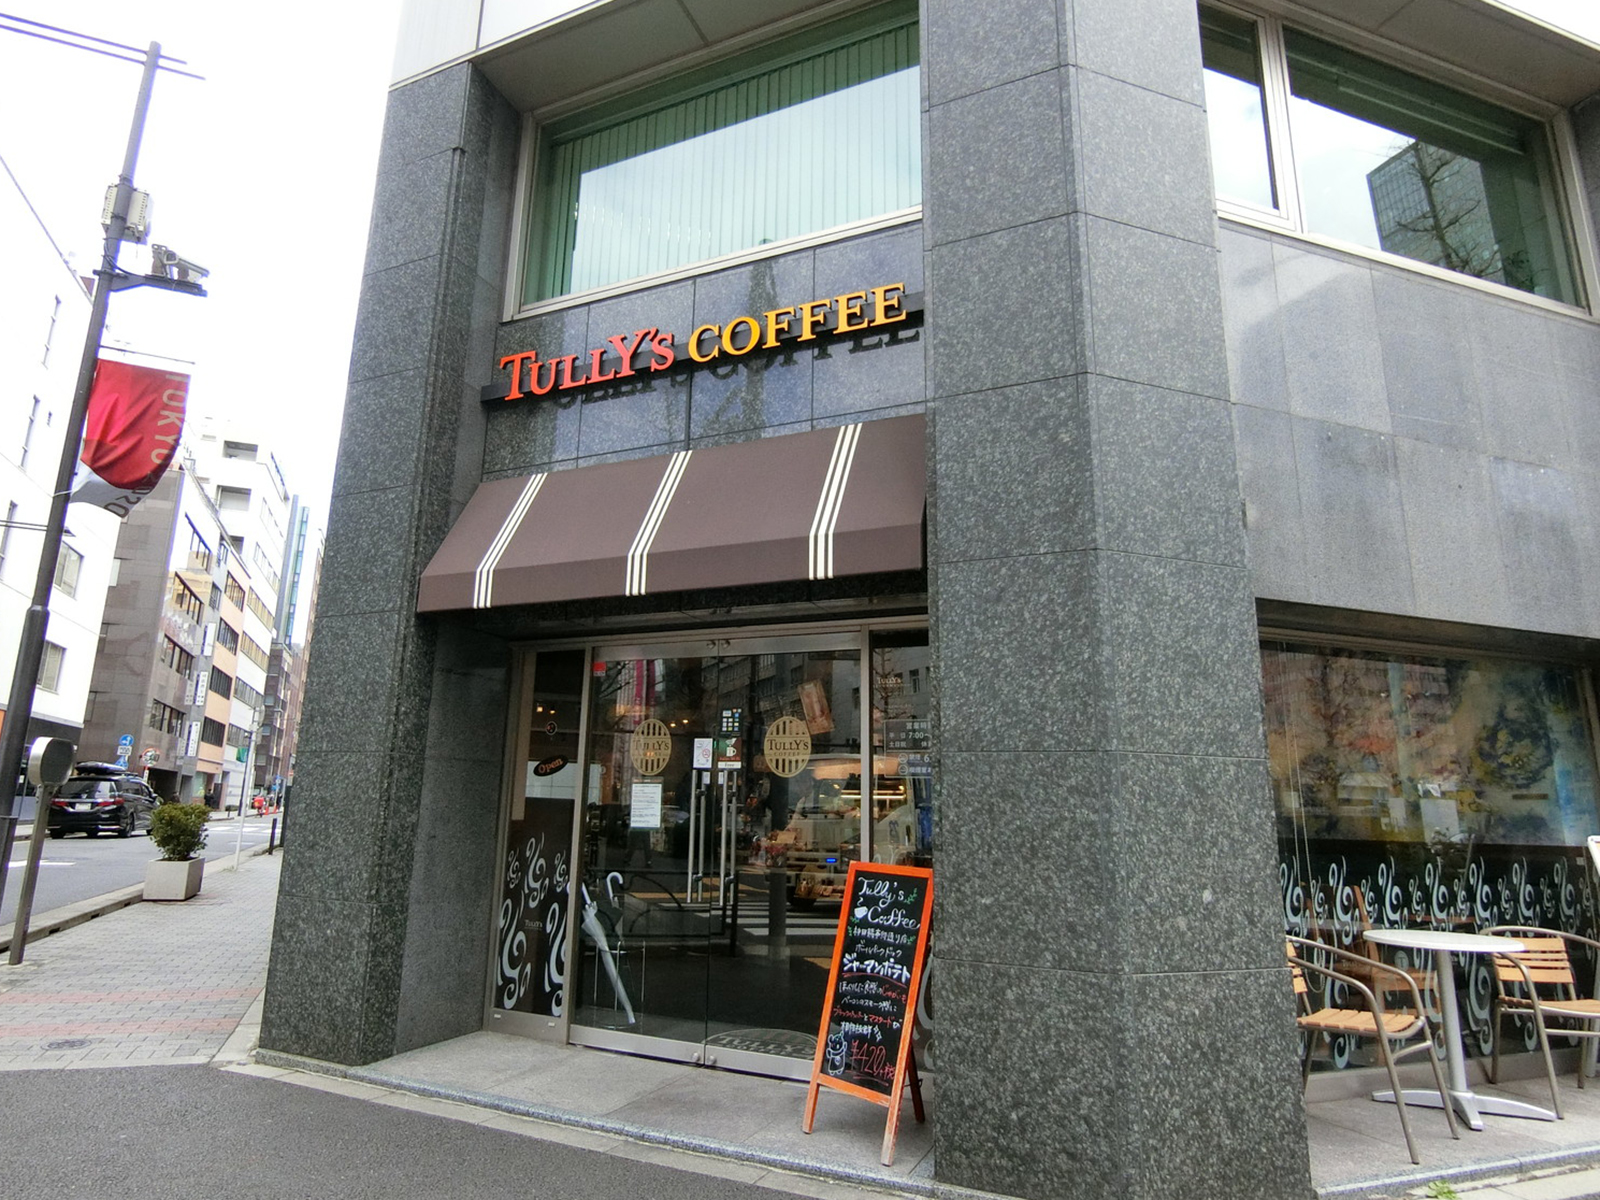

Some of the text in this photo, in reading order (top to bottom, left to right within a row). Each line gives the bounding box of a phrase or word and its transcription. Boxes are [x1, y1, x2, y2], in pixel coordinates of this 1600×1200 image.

[500, 282, 907, 401] TULLY'S COFFEE
[767, 739, 809, 751] TULLY'S
[538, 758, 563, 774] Open
[858, 876, 905, 908] Tully's
[867, 905, 921, 930] Coffee
[843, 952, 911, 983] ジャーマンポテト
